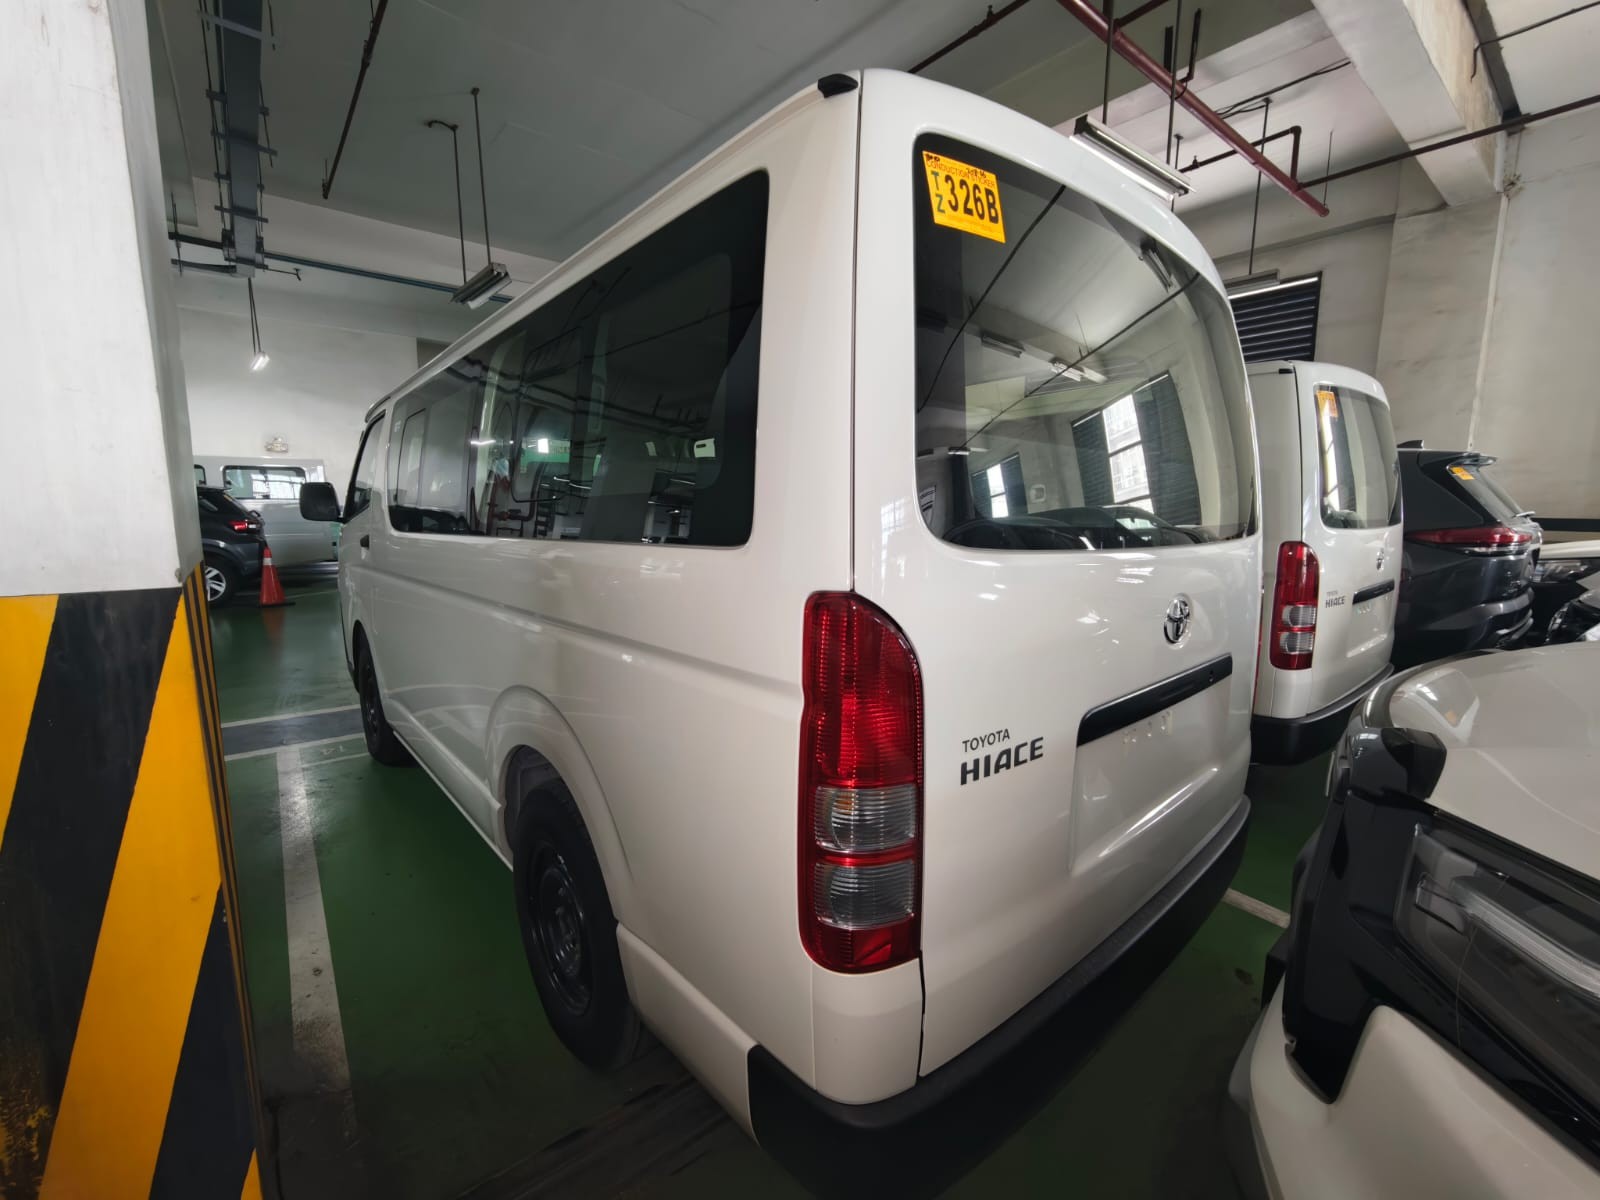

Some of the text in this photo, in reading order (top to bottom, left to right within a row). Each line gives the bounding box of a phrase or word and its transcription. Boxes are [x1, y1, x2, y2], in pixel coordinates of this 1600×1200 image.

[944, 174, 999, 224] 326B
[960, 736, 1044, 786] HIACE
[962, 728, 1010, 752] TOYOTA
